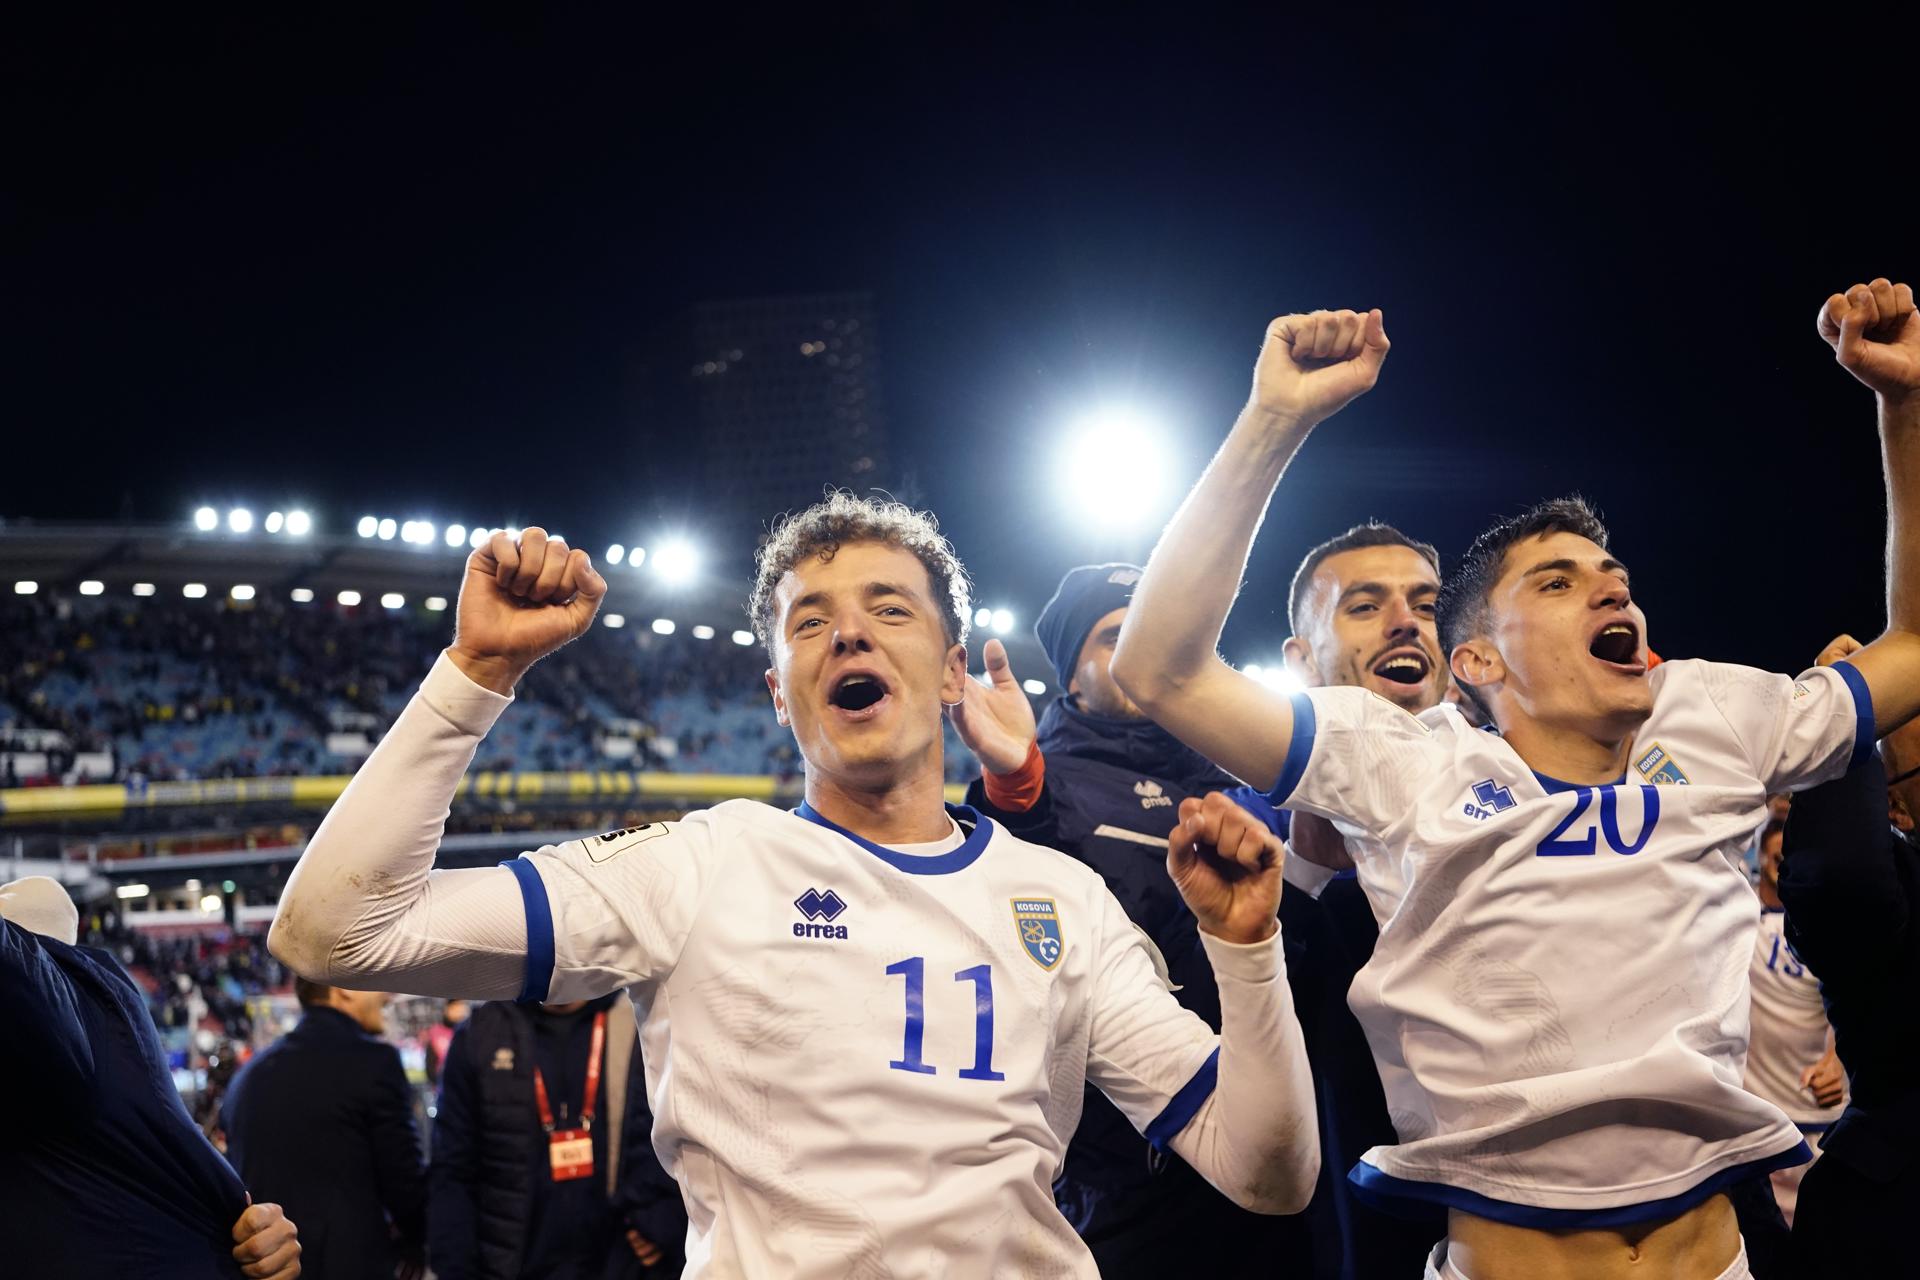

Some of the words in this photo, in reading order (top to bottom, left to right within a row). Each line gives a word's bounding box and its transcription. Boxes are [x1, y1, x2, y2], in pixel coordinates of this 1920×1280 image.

[1639, 749, 1664, 773] KOSOVA
[1463, 802, 1495, 821] err
[1536, 784, 1660, 856] 20
[1016, 902, 1053, 913] KOSOVA
[792, 922, 848, 940] errea
[885, 956, 1006, 1082] 11
